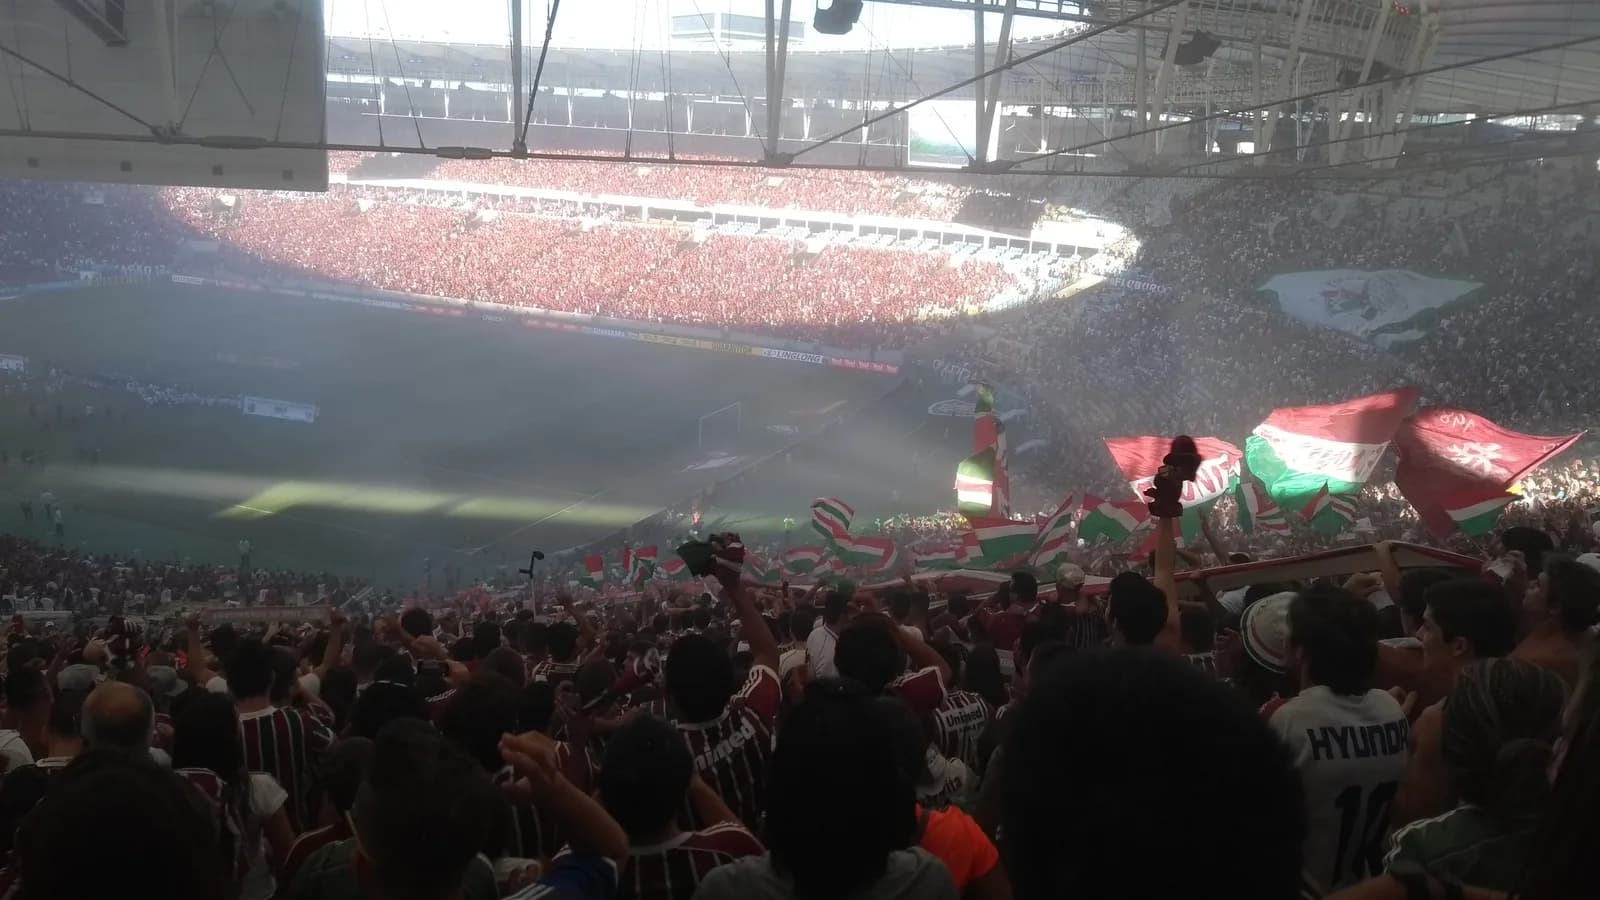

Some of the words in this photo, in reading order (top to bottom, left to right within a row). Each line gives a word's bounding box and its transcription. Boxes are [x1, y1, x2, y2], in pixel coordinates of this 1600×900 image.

[775, 350, 822, 363] LINGLONG
[945, 707, 983, 728] Unimed
[695, 715, 757, 770] nimed
[1306, 718, 1408, 761] HYUNDA
